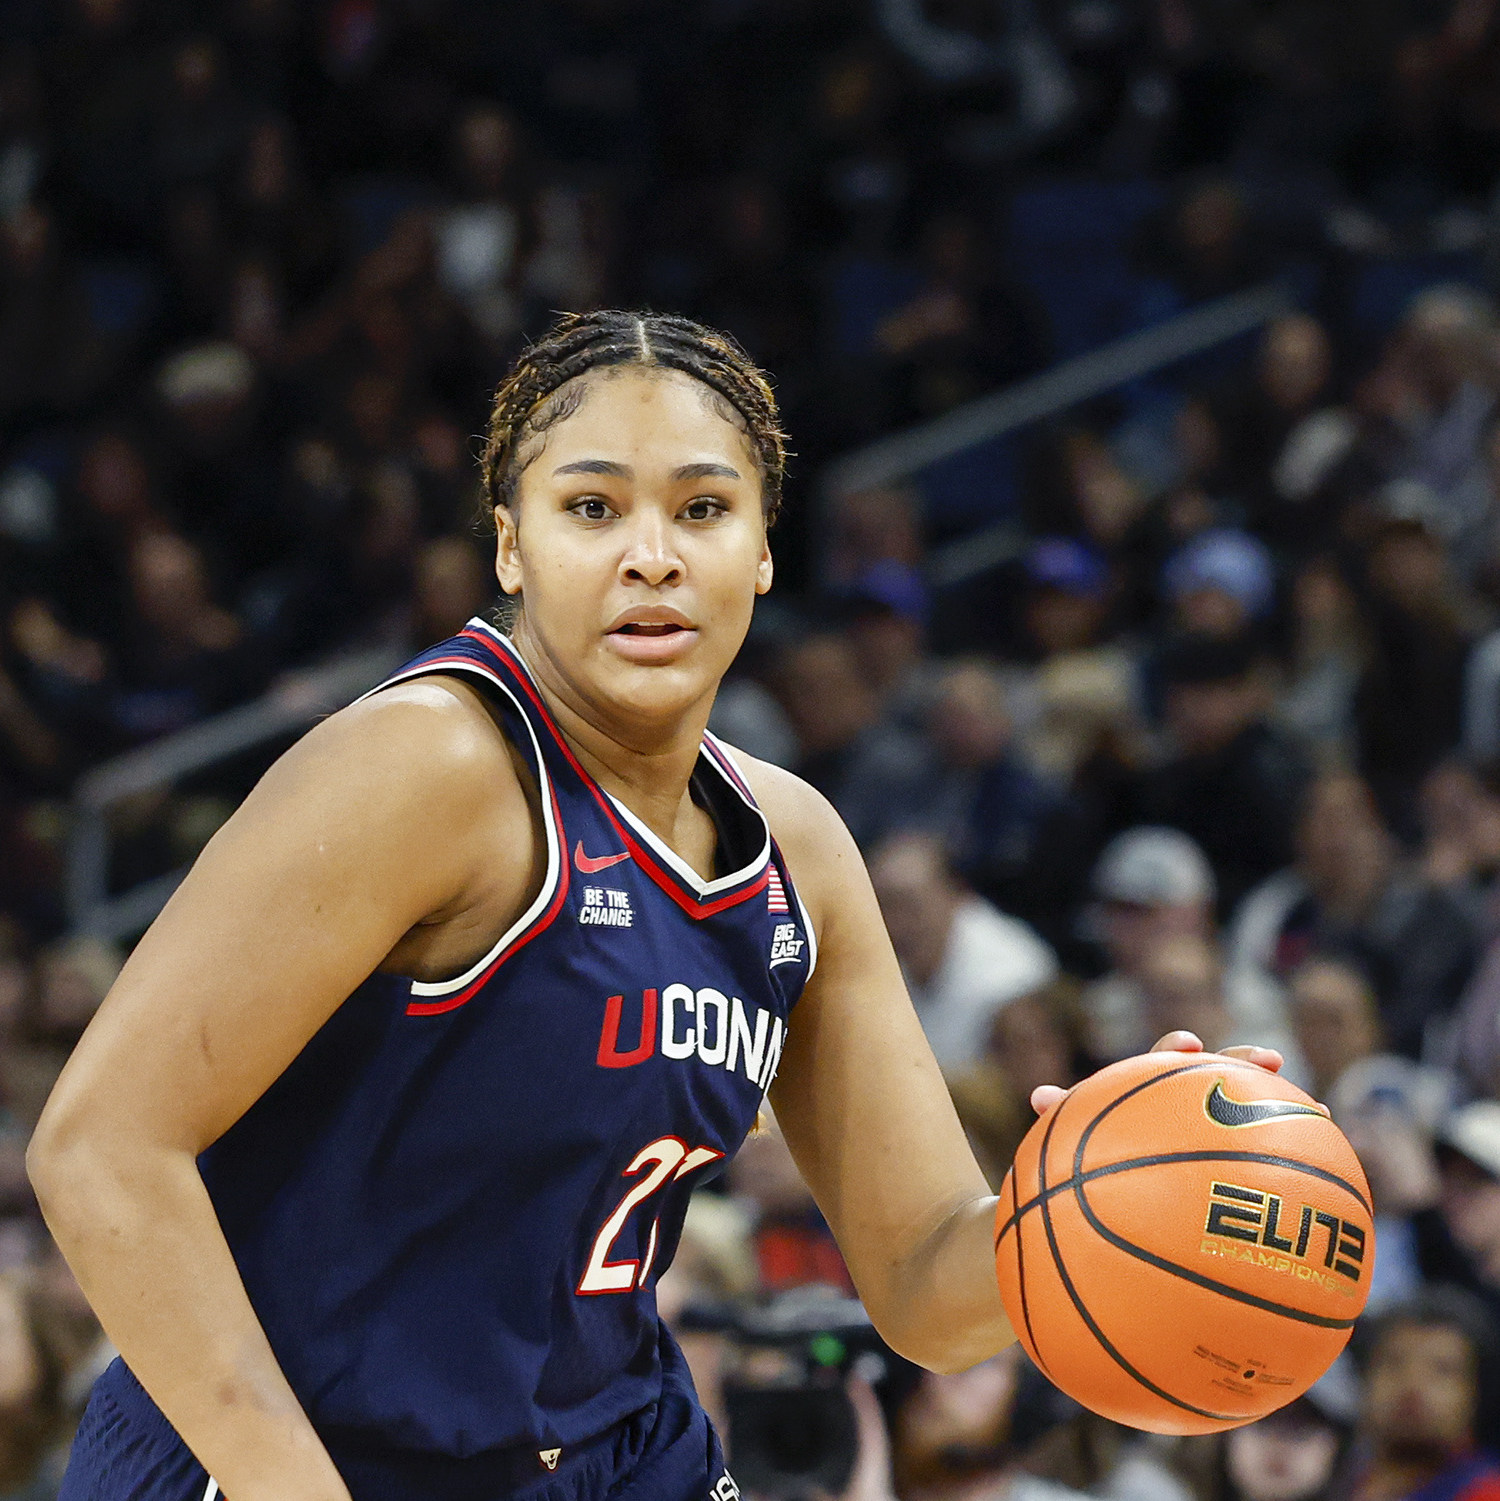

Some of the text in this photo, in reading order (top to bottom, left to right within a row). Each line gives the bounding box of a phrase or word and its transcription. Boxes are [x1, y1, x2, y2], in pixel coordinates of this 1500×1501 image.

[584, 888, 630, 909] BE THE
[579, 906, 633, 927] CHANGE
[773, 923, 796, 942] BIG
[770, 940, 805, 959] EAST
[1205, 1180, 1366, 1284] ELITE
